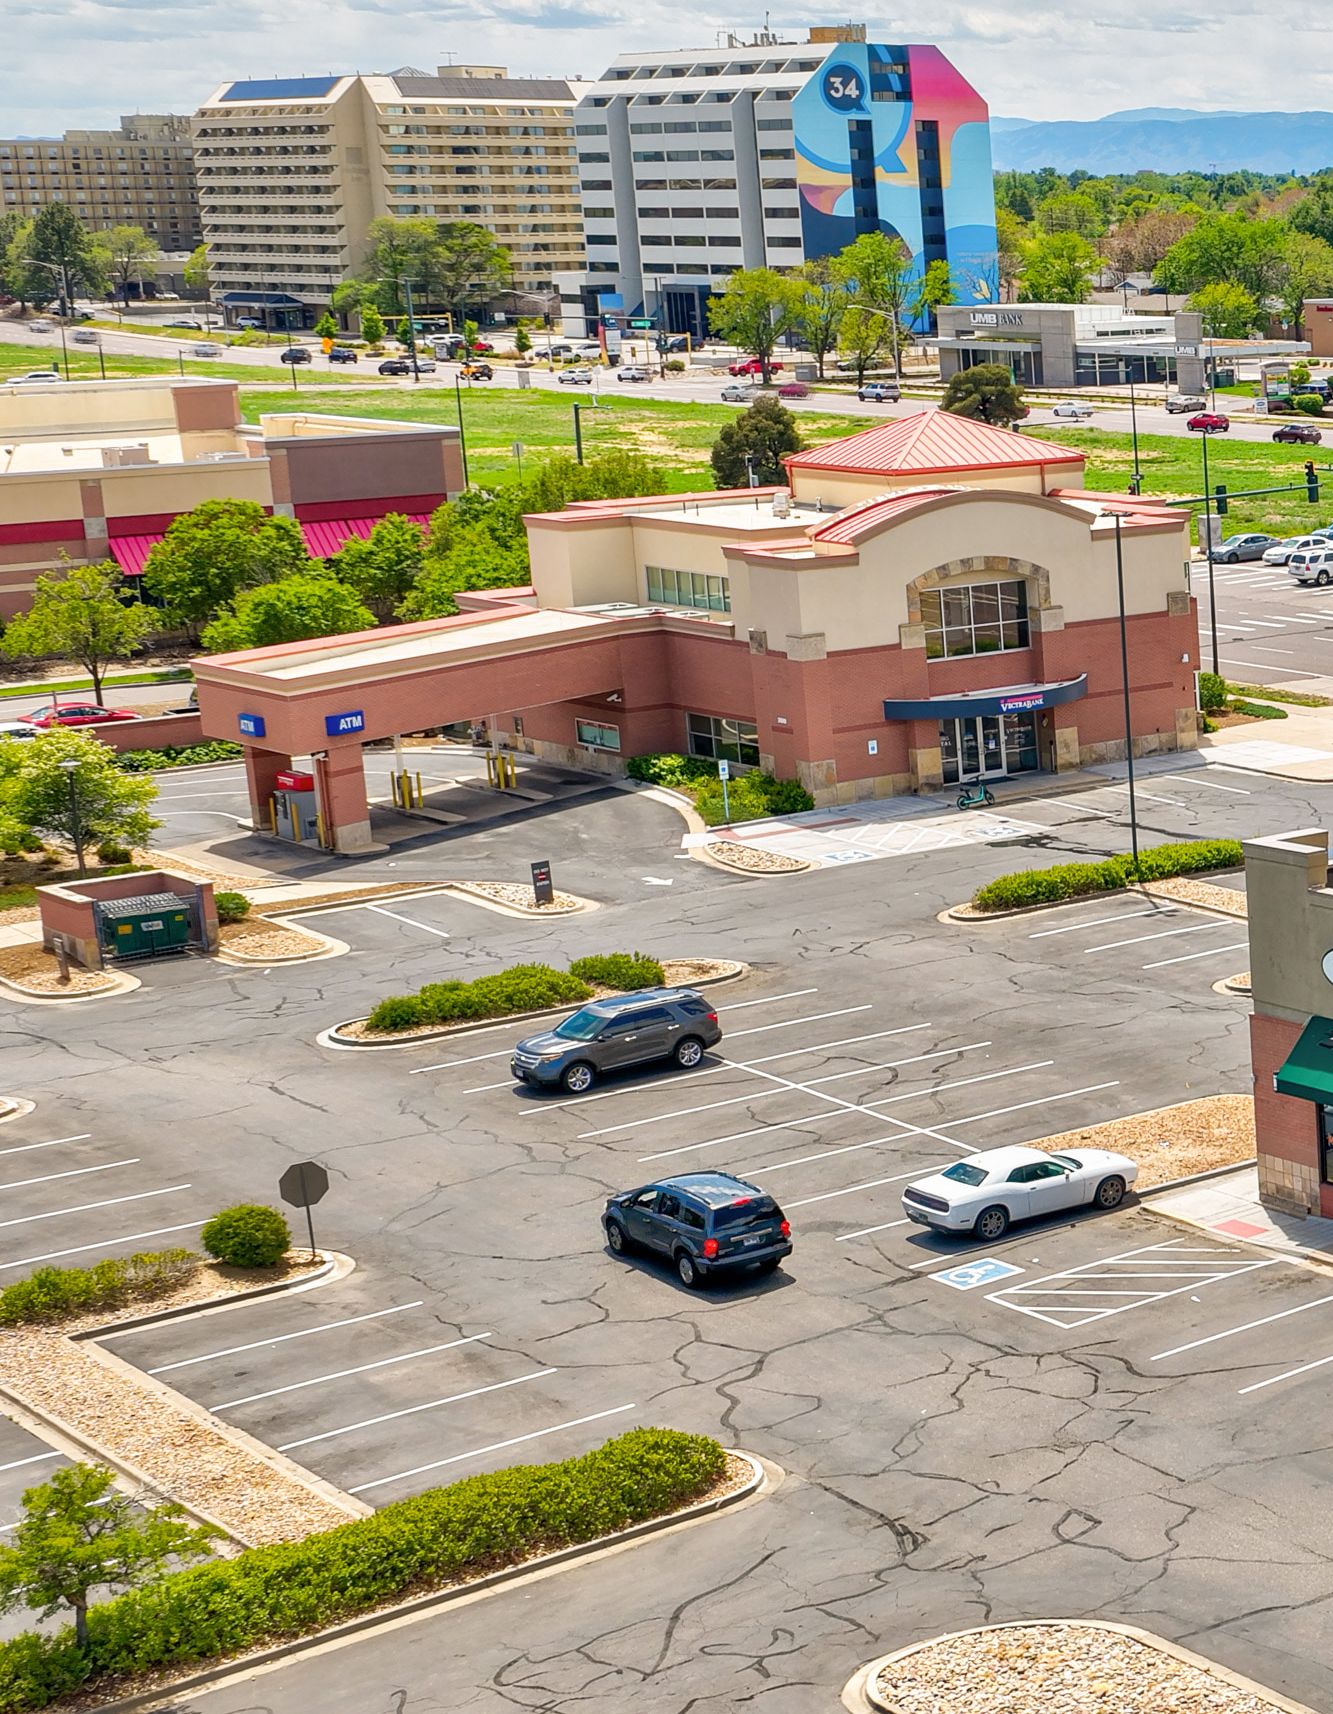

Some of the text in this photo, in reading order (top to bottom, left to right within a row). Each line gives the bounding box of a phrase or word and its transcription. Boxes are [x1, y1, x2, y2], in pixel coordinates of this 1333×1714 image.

[829, 77, 860, 98] 34
[970, 312, 998, 324] UMB
[1175, 346, 1196, 356] UMB
[240, 719, 255, 732] ATM
[339, 715, 363, 730] ATM
